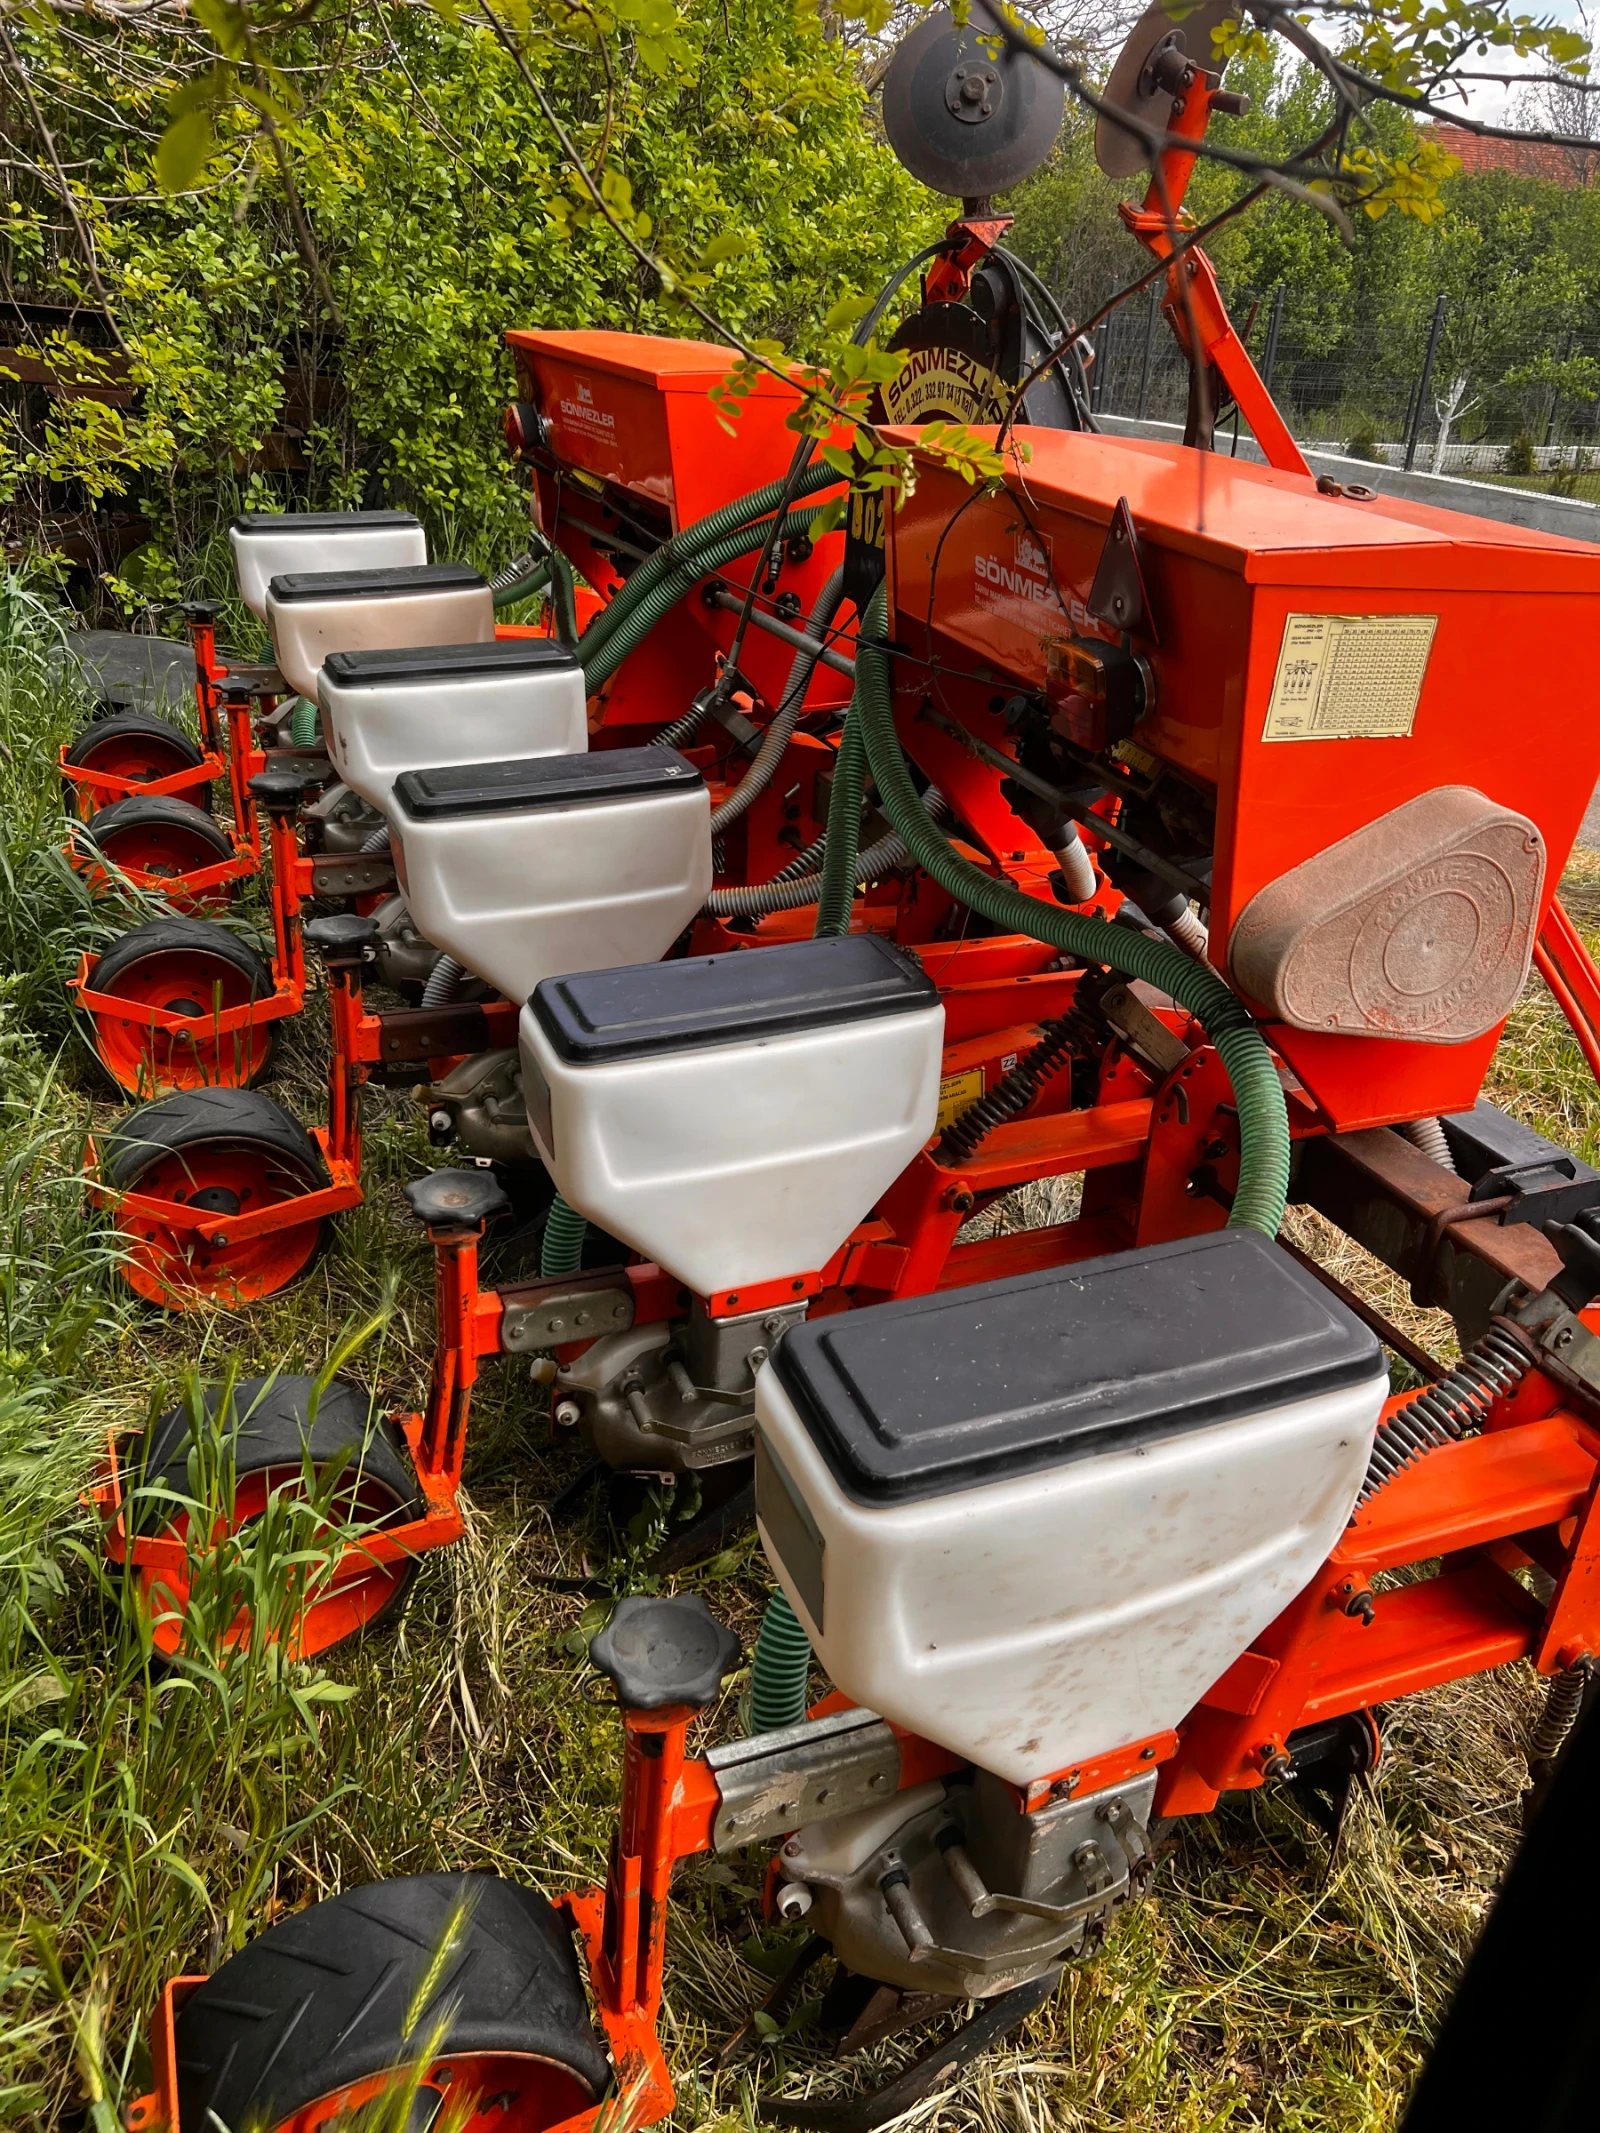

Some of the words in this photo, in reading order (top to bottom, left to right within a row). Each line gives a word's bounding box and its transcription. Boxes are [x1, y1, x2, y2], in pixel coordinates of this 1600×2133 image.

[925, 381, 936, 401] 332
[937, 381, 945, 399] 97
[946, 382, 954, 402] 34
[560, 397, 616, 429] SÖNMEZLER
[1003, 1058, 1016, 1068] Z2
